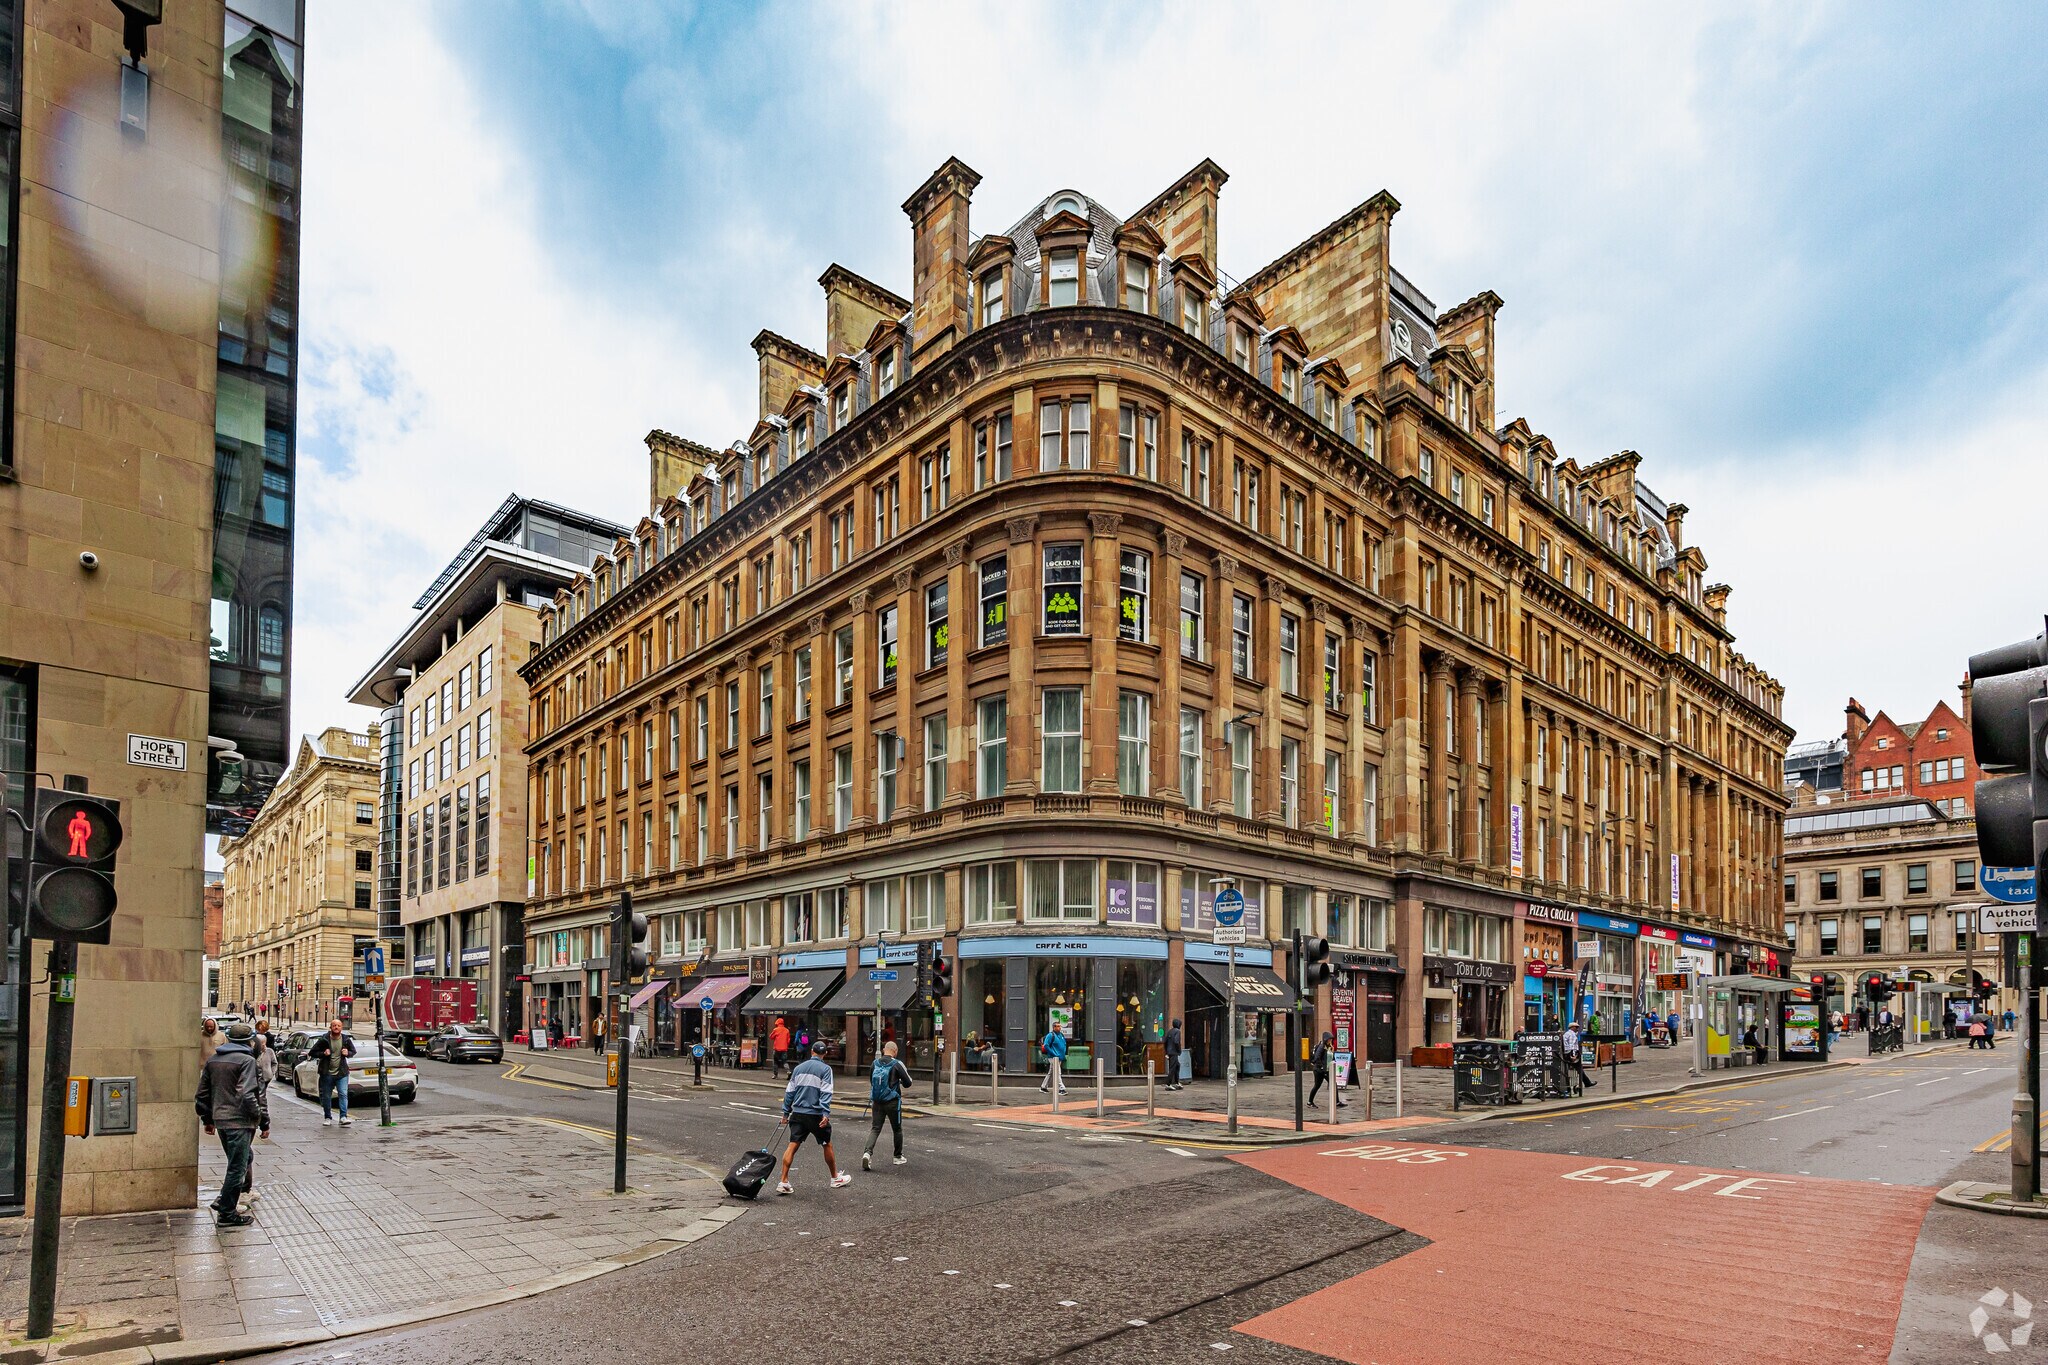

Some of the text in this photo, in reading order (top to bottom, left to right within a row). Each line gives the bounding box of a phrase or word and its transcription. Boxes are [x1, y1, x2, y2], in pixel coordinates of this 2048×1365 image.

[1045, 560, 1071, 568] LOCKED
[140, 740, 174, 753] HOPE
[133, 750, 180, 765] STREET
[2008, 886, 2033, 896] taxi
[1107, 906, 1131, 915] LOANS
[1529, 903, 1575, 922] PIZZA CROLLA
[752, 972, 764, 980] FOX
[1453, 961, 1493, 978] TOBY JUG
[765, 987, 813, 999] NERO
[1223, 981, 1284, 996] NERO
[1332, 995, 1353, 1003] HEAVEN
[1317, 1145, 1469, 1164] BUS
[1561, 1165, 1797, 1200] GATE
